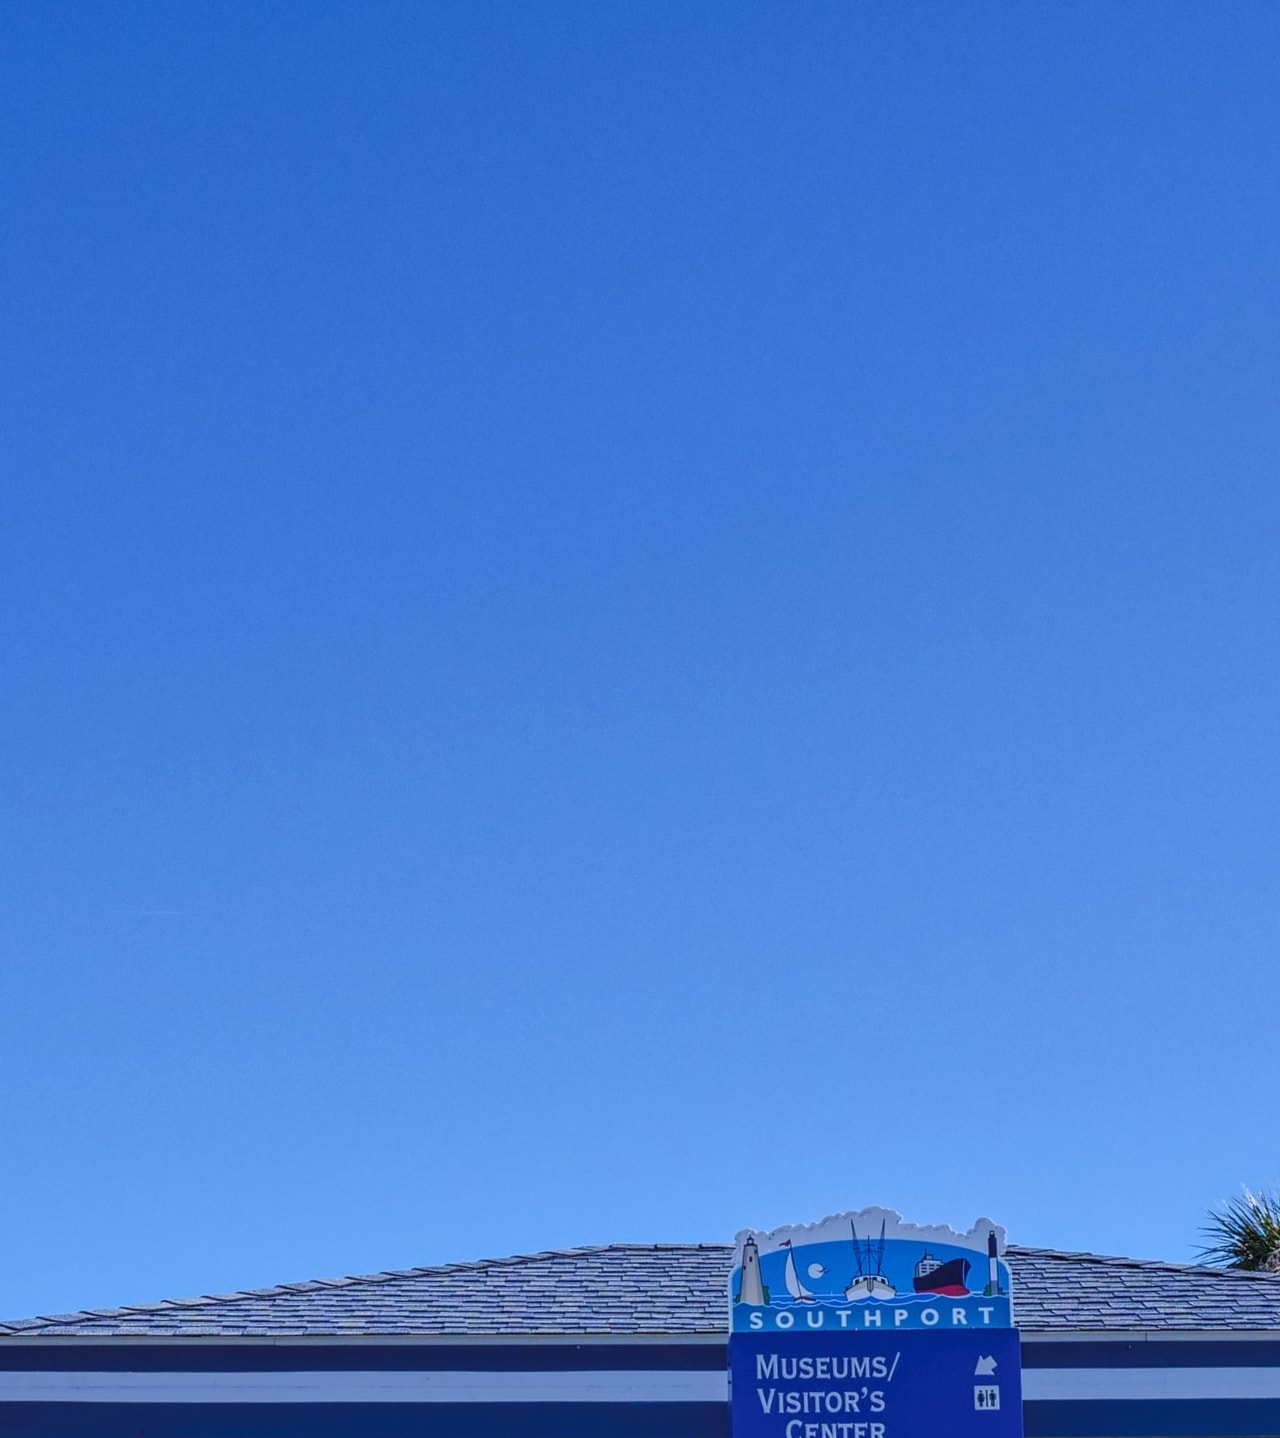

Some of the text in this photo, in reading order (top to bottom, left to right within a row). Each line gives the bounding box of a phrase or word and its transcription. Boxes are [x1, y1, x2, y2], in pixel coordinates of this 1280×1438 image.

[749, 1306, 995, 1329] SOUTHPORT
[756, 1352, 900, 1382] MUSEUMS/
[757, 1386, 886, 1414] VISITOR'S
